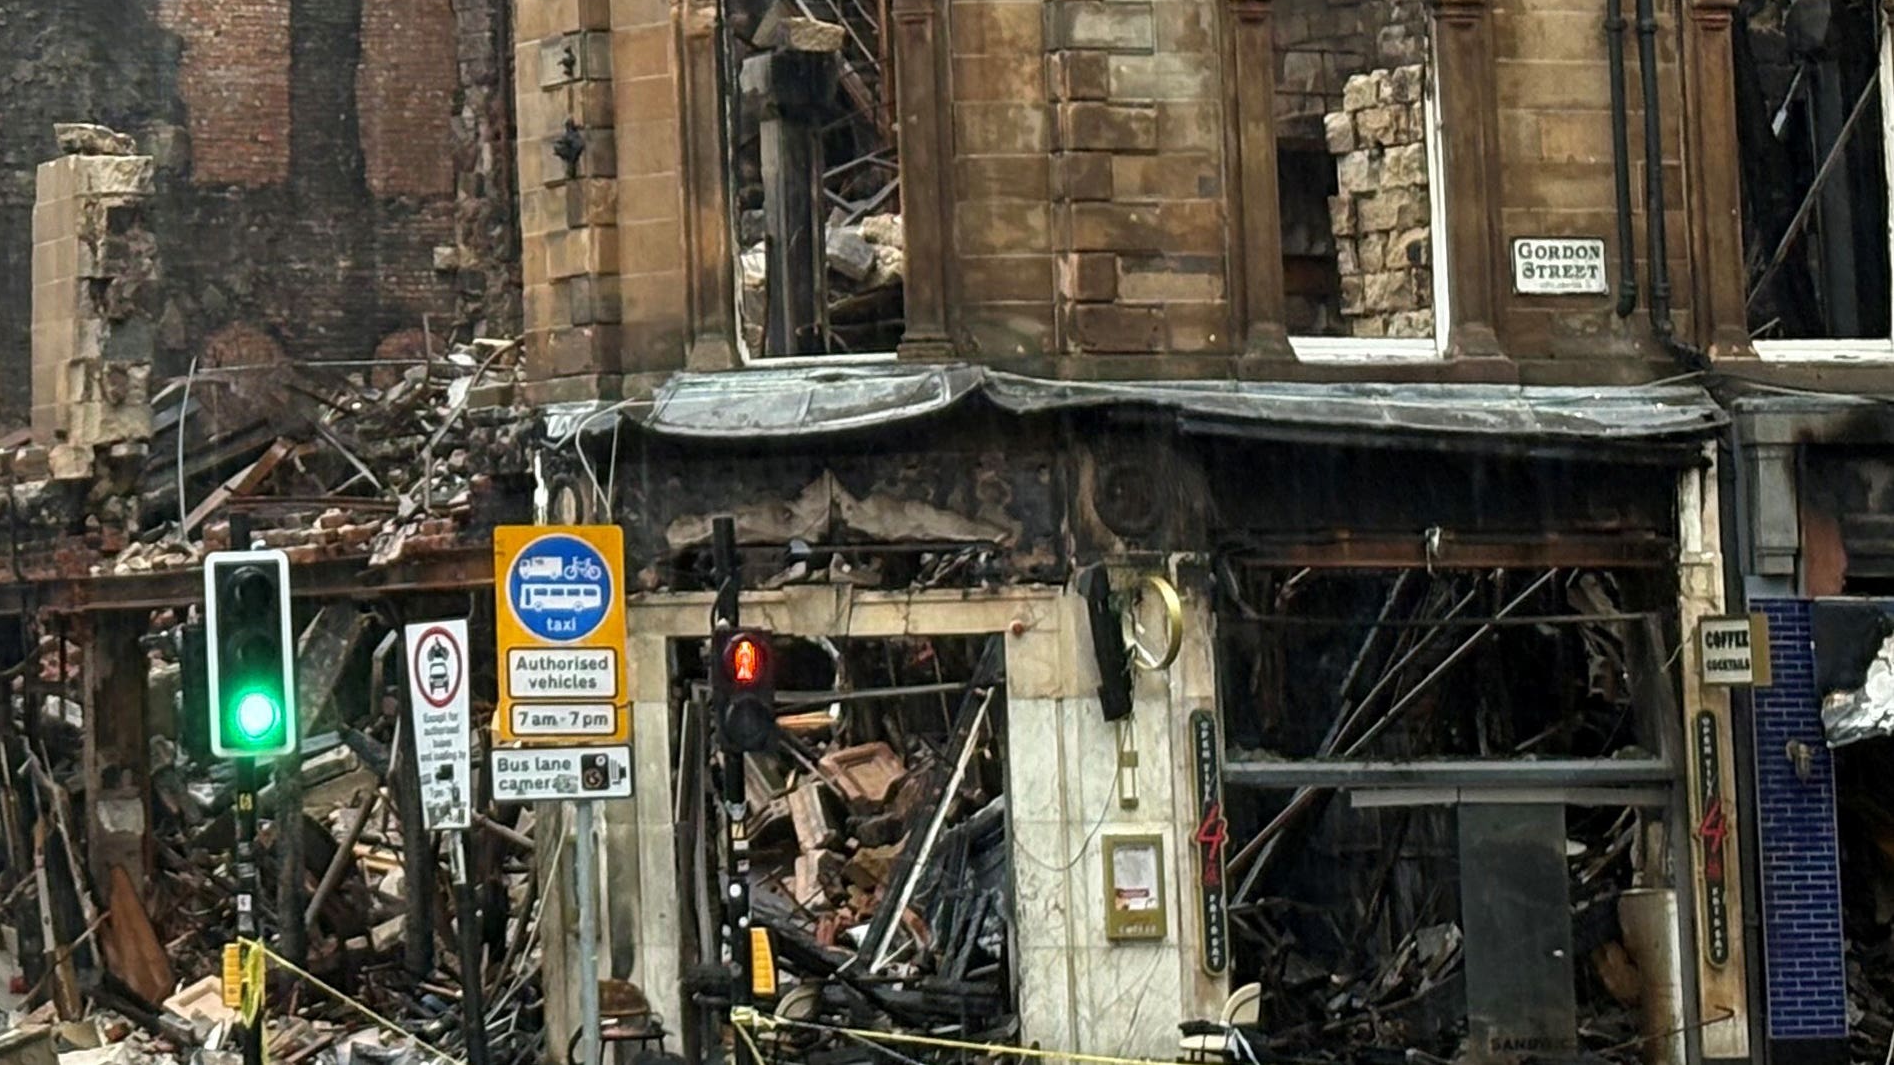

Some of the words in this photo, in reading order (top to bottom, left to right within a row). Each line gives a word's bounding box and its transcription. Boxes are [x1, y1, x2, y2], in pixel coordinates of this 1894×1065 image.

[1518, 242, 1600, 260] GORDON
[1522, 261, 1599, 279] STREET
[546, 617, 577, 632] taxi
[1705, 630, 1749, 649] COFFEE
[515, 655, 609, 671] Authorised
[1706, 657, 1750, 671] COCKTAILS
[528, 674, 597, 690] vehicles
[497, 757, 529, 773] Bus
[535, 757, 572, 772] lane
